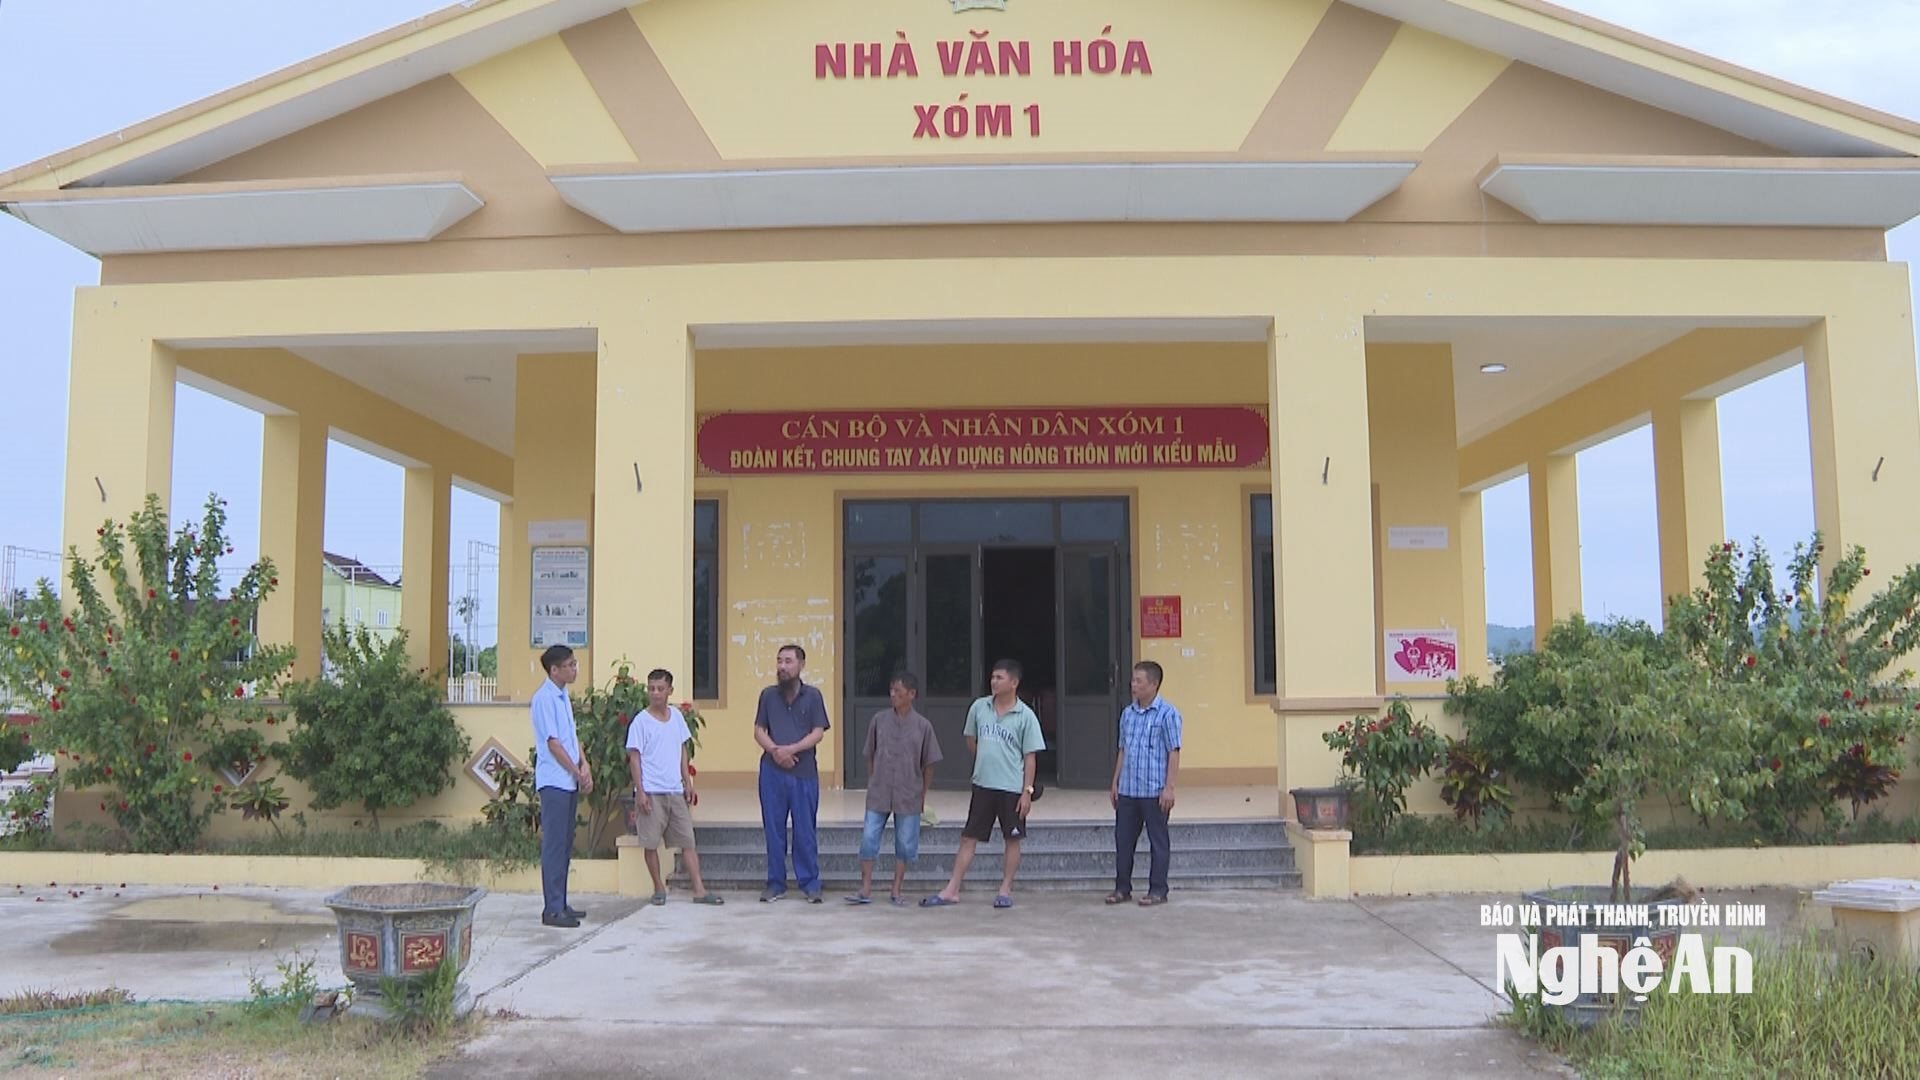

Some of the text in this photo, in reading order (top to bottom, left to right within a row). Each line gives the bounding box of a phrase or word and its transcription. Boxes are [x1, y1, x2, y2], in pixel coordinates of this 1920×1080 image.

[815, 25, 1153, 80] NHÀ VĂN HÓA
[912, 93, 1040, 139] XÓM 1
[781, 411, 1185, 442] CÁN BỘ VÀ NHÂN DÂN XÓM 1
[730, 437, 1237, 470] ĐOÀN KẾT, CHUNG TAY XÂY DỰNG NÔNG THÔN MỚI KIỂU MẪU
